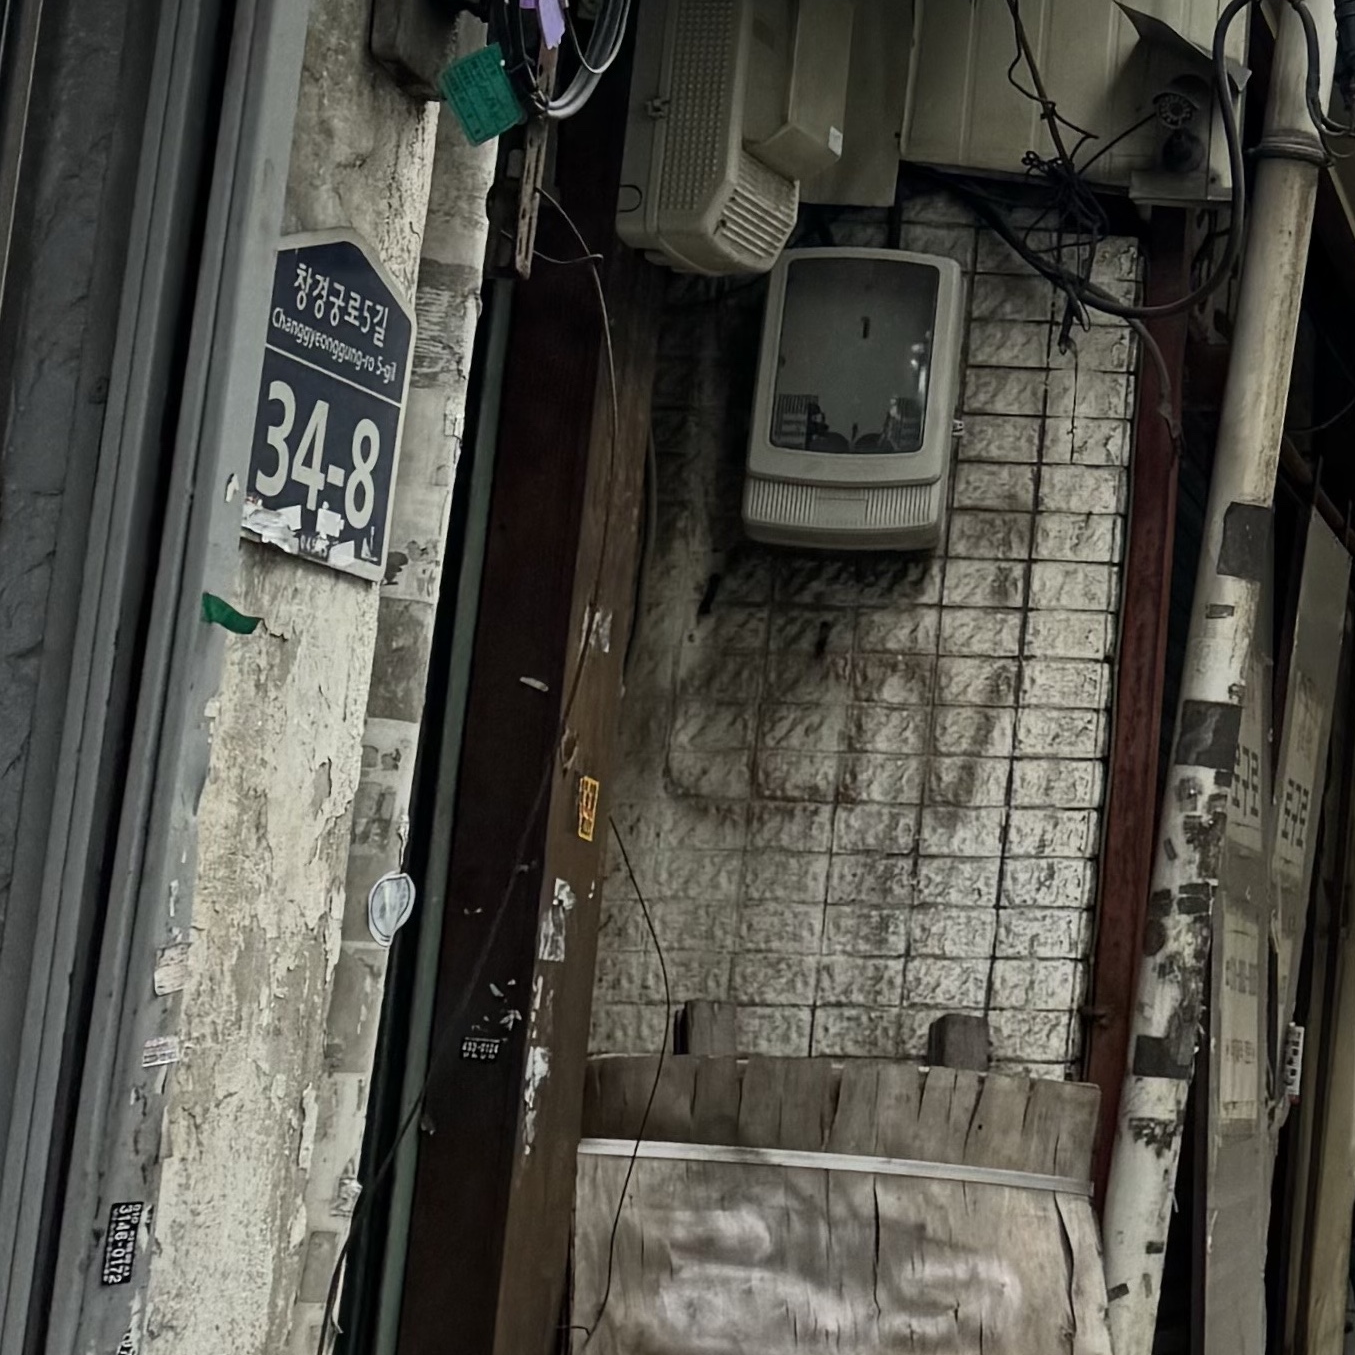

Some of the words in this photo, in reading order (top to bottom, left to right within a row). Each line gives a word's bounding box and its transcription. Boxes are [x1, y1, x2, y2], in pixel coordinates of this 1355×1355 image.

[272, 306, 375, 376] Changgyeonggung-ro
[375, 355, 397, 384] 5-gil
[293, 262, 389, 348] 창경궁로5길
[254, 379, 381, 530] 34-8
